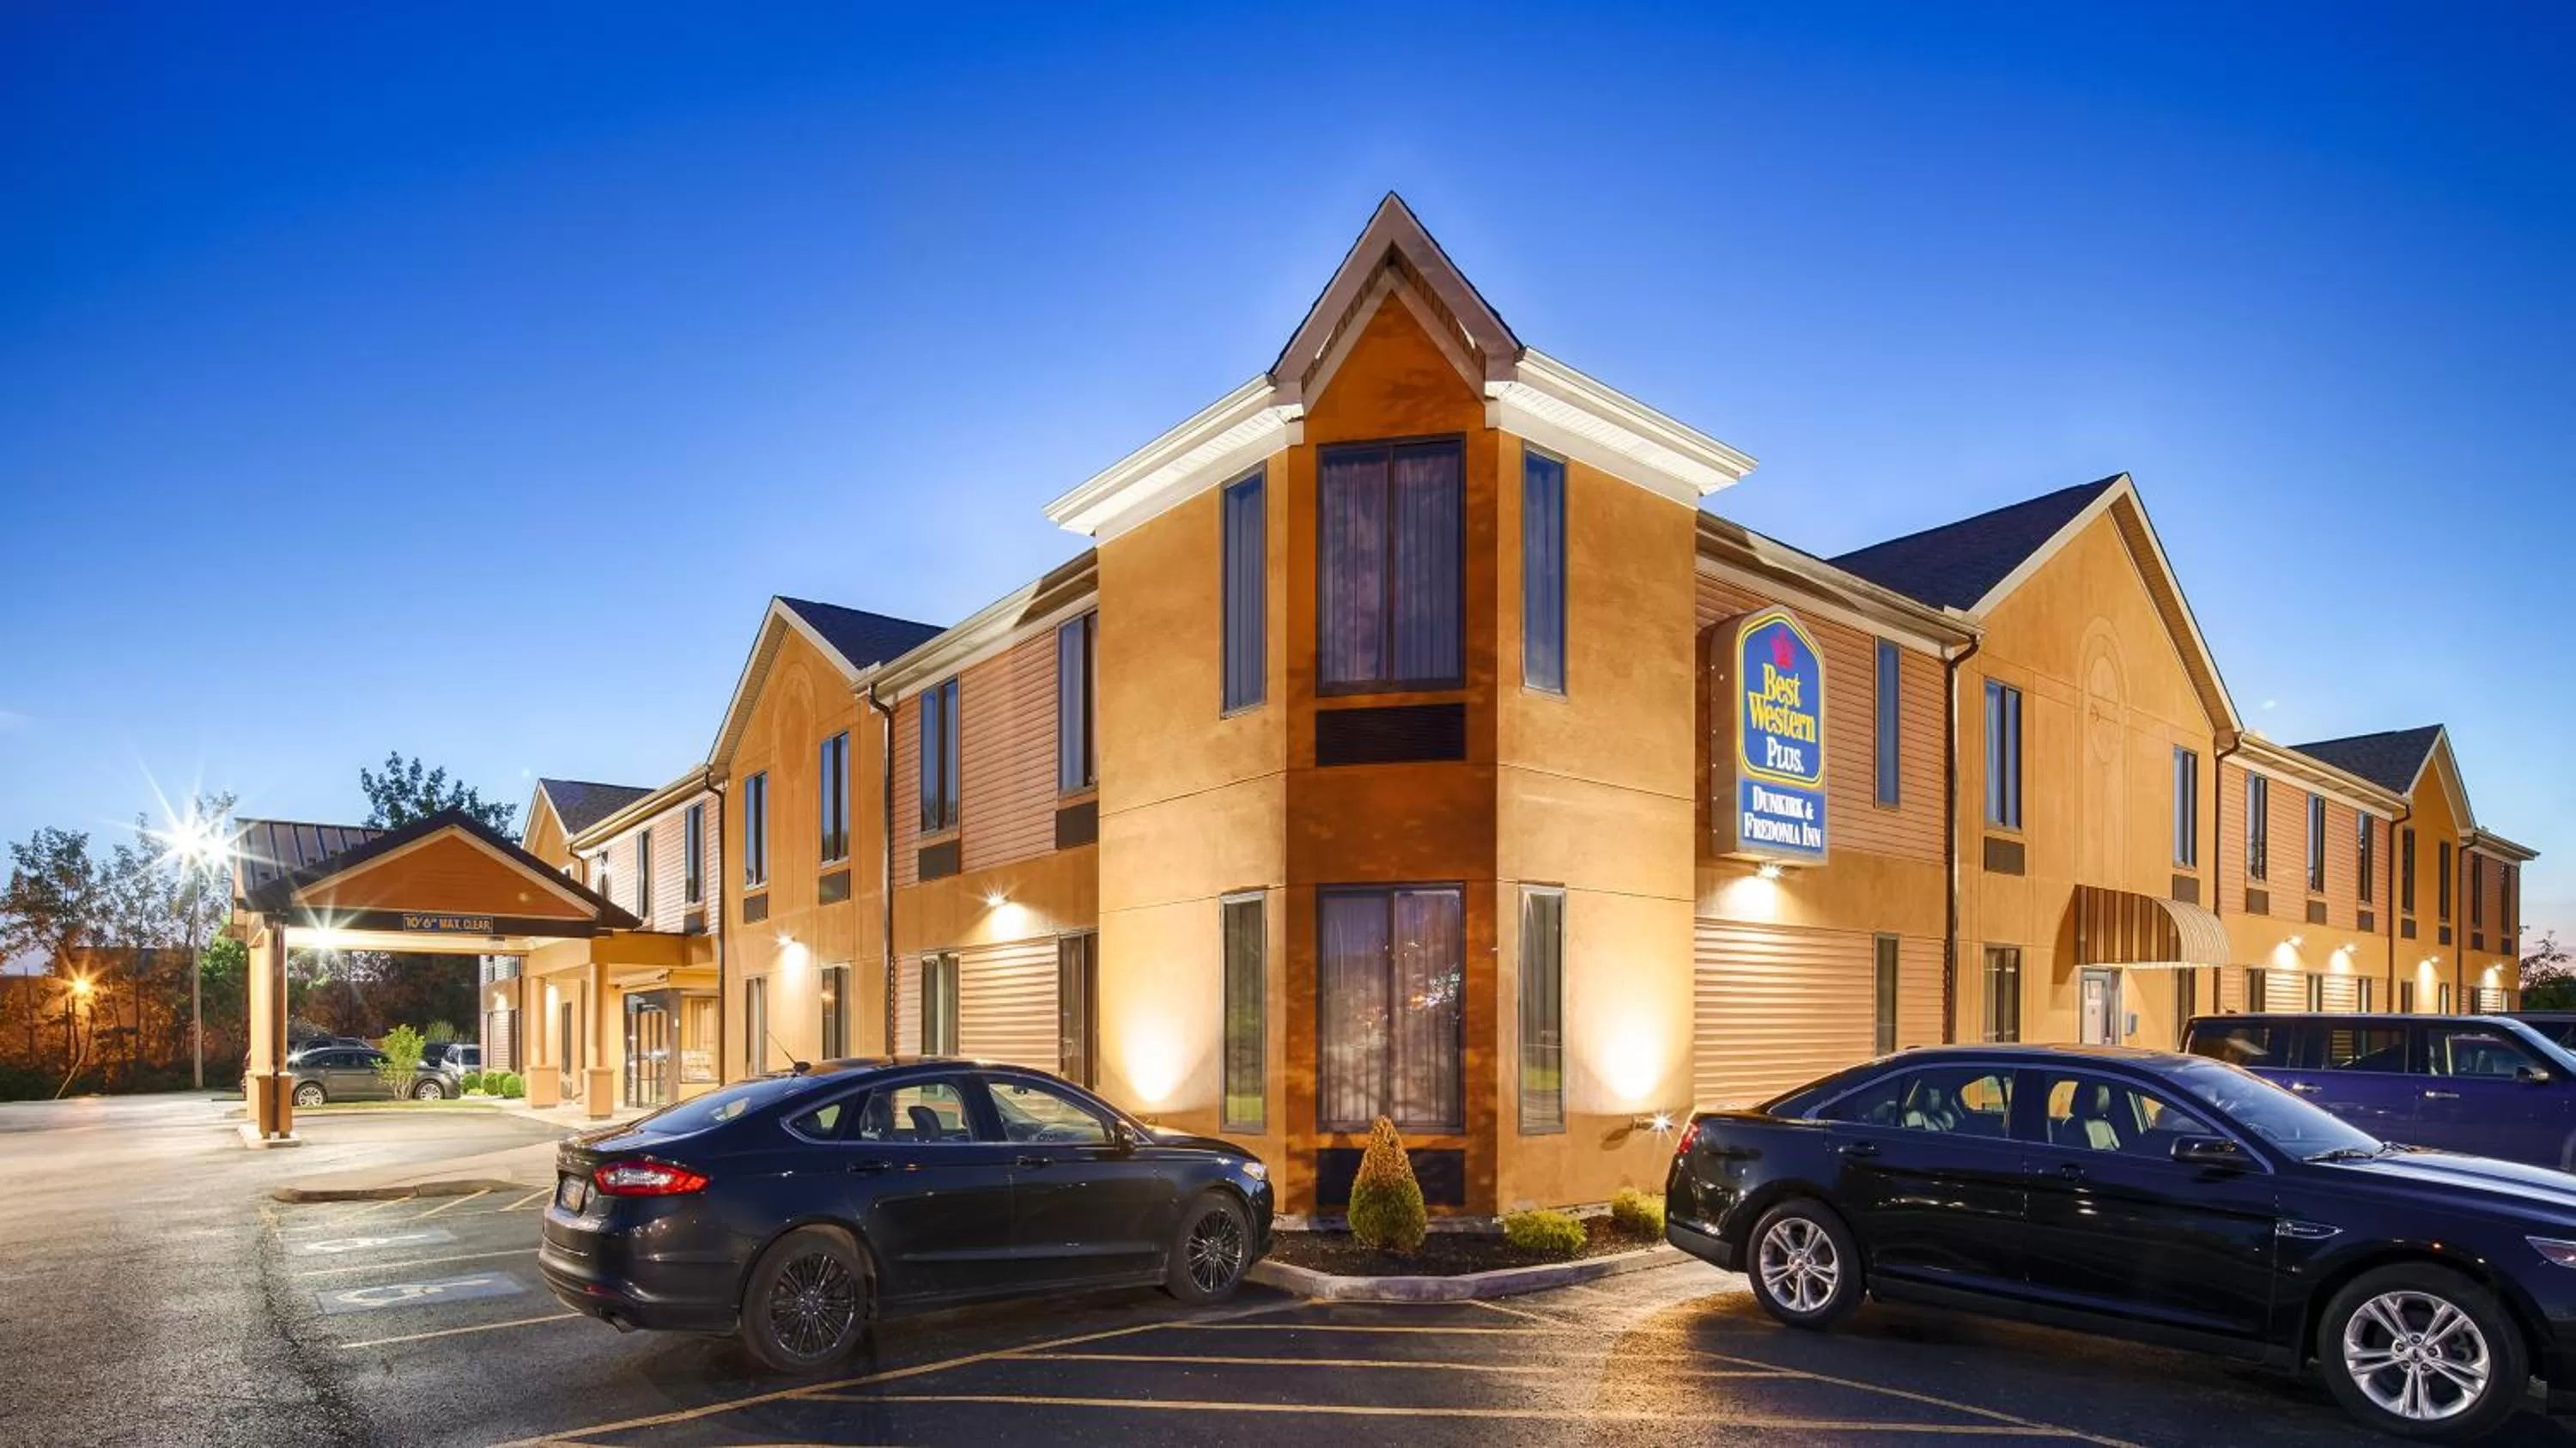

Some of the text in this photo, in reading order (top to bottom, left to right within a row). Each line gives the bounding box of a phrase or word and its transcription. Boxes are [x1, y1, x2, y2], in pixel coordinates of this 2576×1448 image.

[1763, 663, 1801, 708] Best
[1748, 691, 1816, 743] Western
[1753, 785, 1814, 820] DUNKIRK &
[1744, 812, 1821, 848] FREDONIA INN
